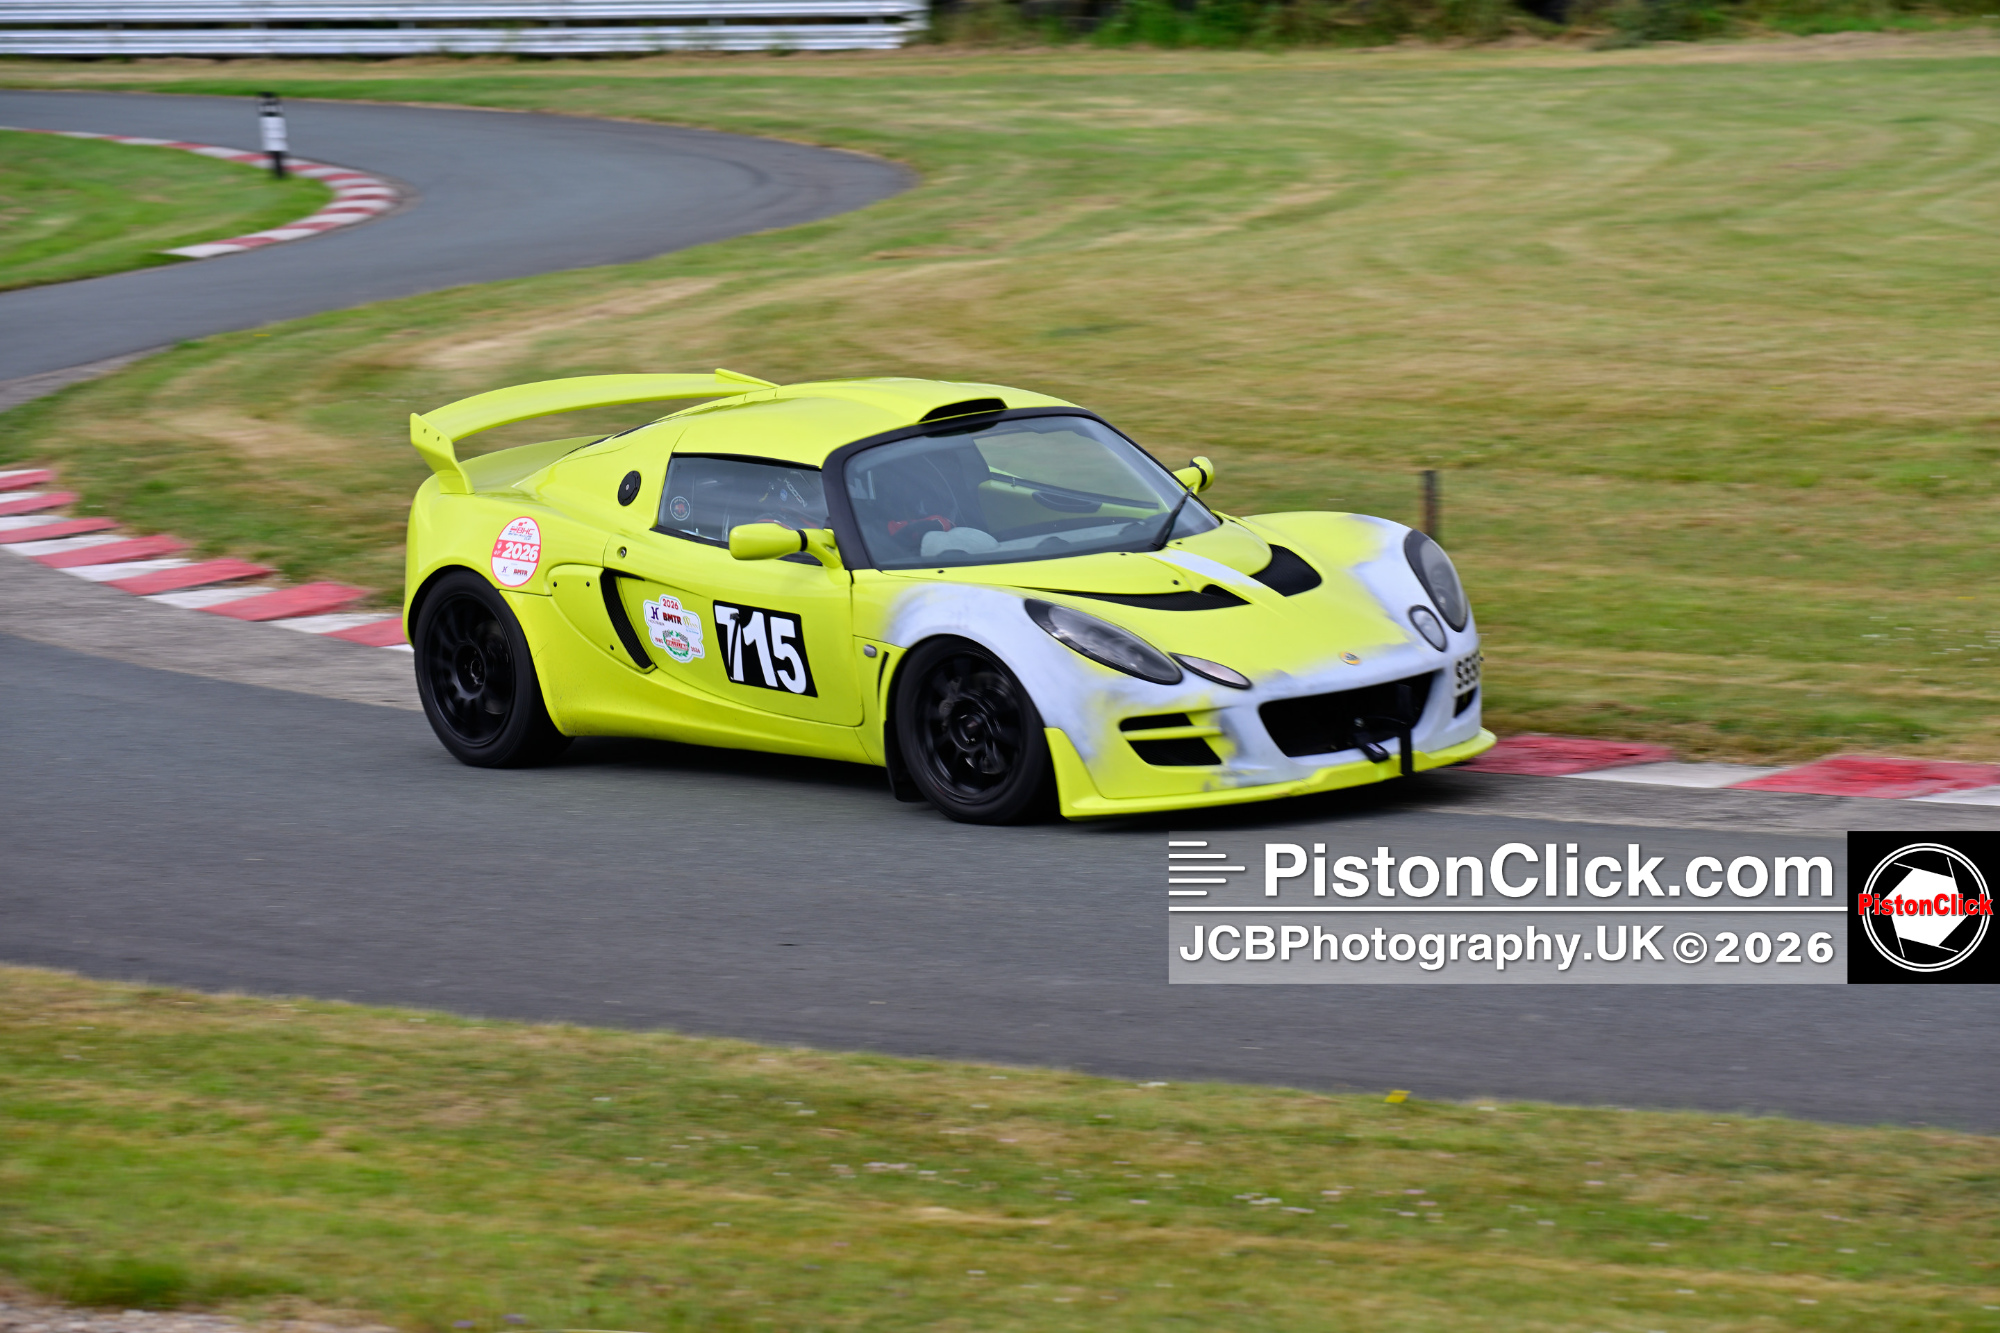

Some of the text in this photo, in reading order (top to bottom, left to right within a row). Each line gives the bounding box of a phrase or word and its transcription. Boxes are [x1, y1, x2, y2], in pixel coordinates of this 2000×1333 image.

[501, 541, 540, 562] 2026
[662, 598, 679, 610] 2026
[662, 611, 683, 626] BMTR
[714, 605, 807, 694] 715
